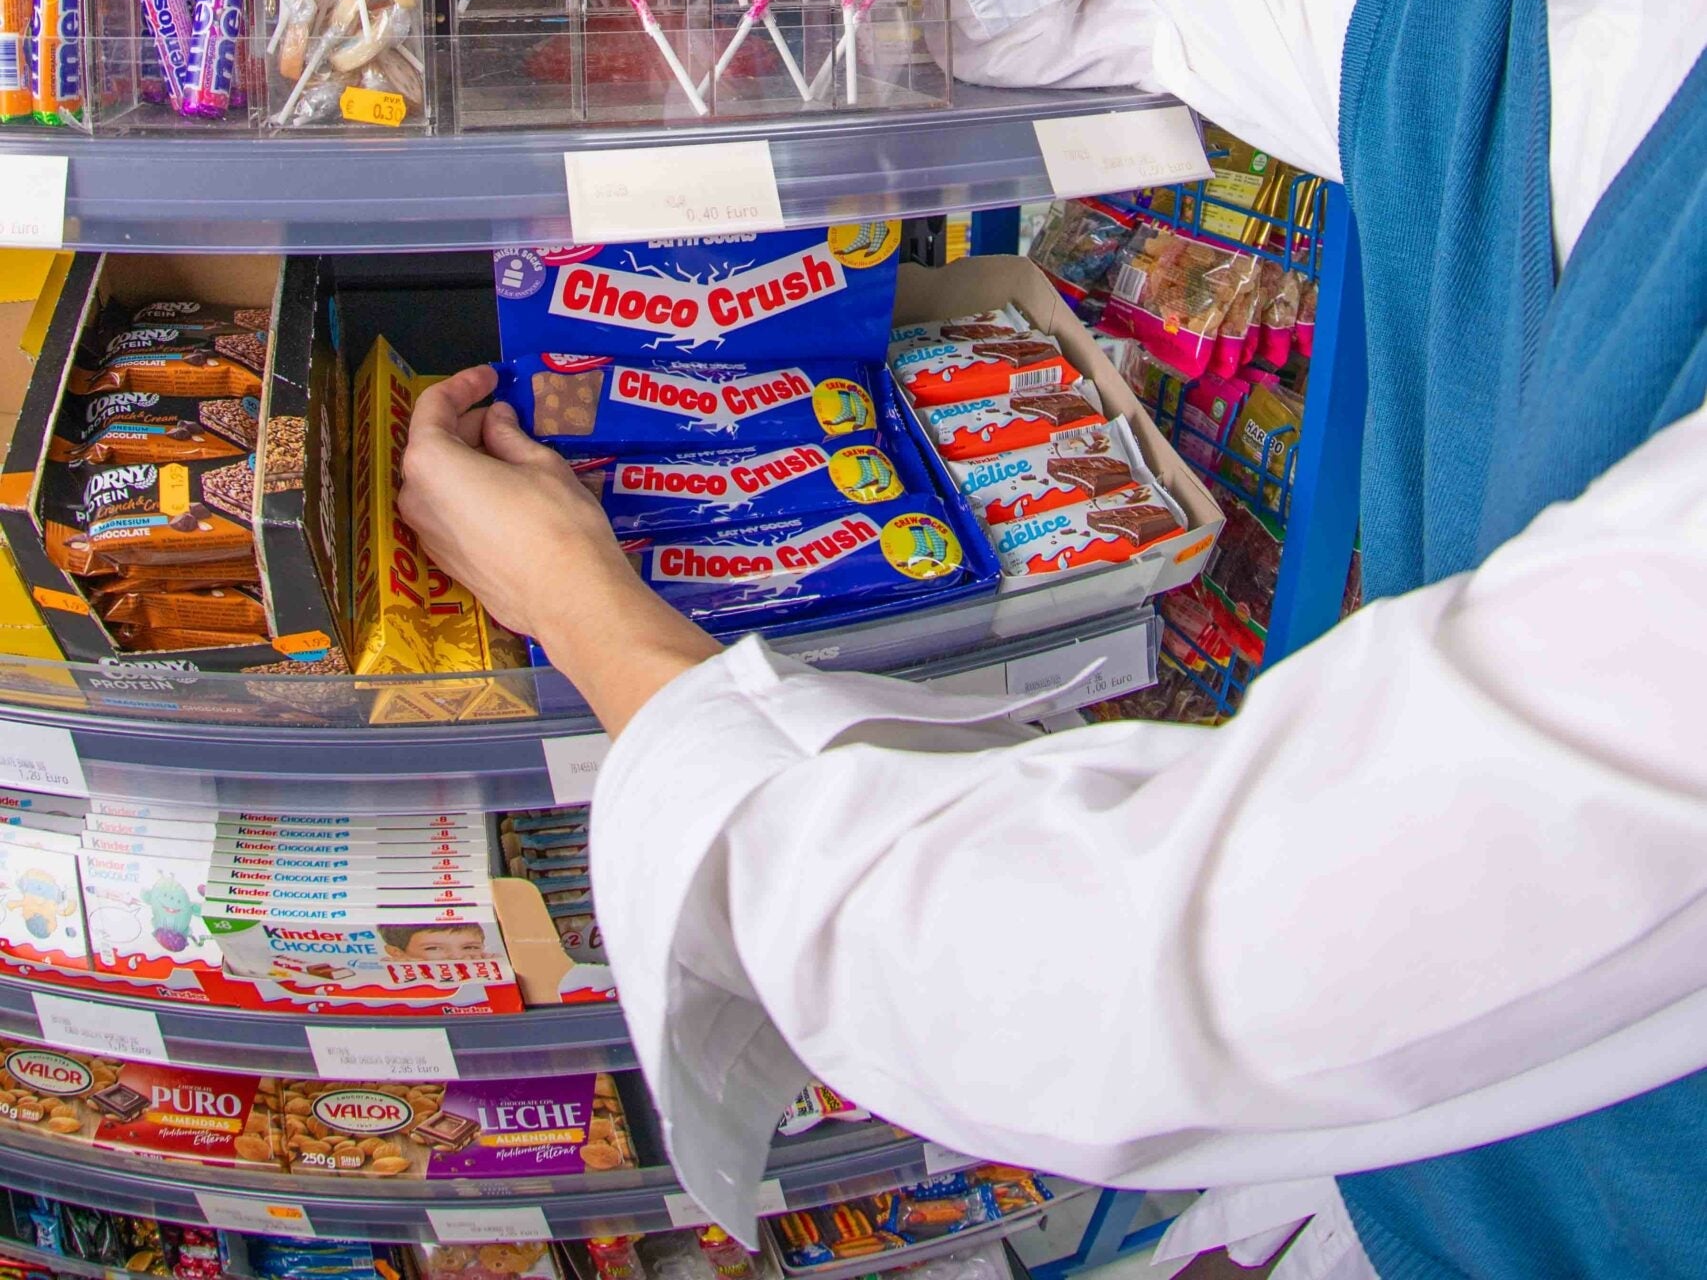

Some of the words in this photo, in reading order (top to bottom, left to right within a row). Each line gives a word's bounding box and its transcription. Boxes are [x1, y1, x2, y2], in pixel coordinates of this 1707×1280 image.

[726, 204, 759, 220] Euro
[522, 250, 543, 272] SOCKS
[562, 268, 699, 328] Choco
[707, 254, 836, 327] Crush
[114, 359, 166, 369] CHOCOLATE
[618, 370, 718, 414] Choco
[721, 371, 812, 416] Crush
[87, 392, 151, 422] CORNY
[621, 466, 727, 496] Choco
[731, 447, 826, 494] Crush
[960, 459, 1032, 496] délice
[894, 515, 919, 528] CREW
[93, 528, 150, 541] CHOCOLATE
[998, 515, 1071, 554] délice
[660, 547, 773, 579] Choco
[776, 519, 878, 574] Crush
[89, 677, 175, 691] PROTEIN
[1111, 672, 1133, 688] Euro
[45, 772, 69, 785] Euro
[240, 813, 277, 823] Kinder
[280, 815, 333, 824] CHOCOLATE
[238, 827, 276, 837] Kinder
[280, 829, 333, 838] CHOCOLATE
[92, 837, 129, 852] Kinder
[236, 841, 275, 851] Kinder
[277, 844, 332, 853] CHOCOLATE
[234, 856, 273, 866] Kinder
[276, 859, 331, 867] CHOCOLATE
[231, 870, 271, 881] Kinder
[274, 873, 330, 883] CHOCOLATE
[229, 886, 269, 897] Kinder
[272, 890, 329, 900] CHOCOLATE
[225, 905, 267, 916] Kinder
[270, 908, 328, 918] CHOCOLATE
[262, 924, 343, 942] Kinder
[270, 939, 378, 956] CHOCOLATE
[158, 988, 207, 1002] Kinder
[442, 1006, 491, 1015] Kinder
[16, 1057, 83, 1085] VALOR
[151, 1086, 242, 1117] PURO
[500, 1099, 536, 1107] CHOCOLATE
[538, 1098, 554, 1106] CON
[324, 1102, 402, 1121] VALOR
[477, 1102, 586, 1131] LECHE
[161, 1114, 231, 1130] ALMENDRAS
[193, 1132, 233, 1146] Enteras
[496, 1131, 572, 1145] ALMENDRAS
[535, 1145, 577, 1163] Enteras
